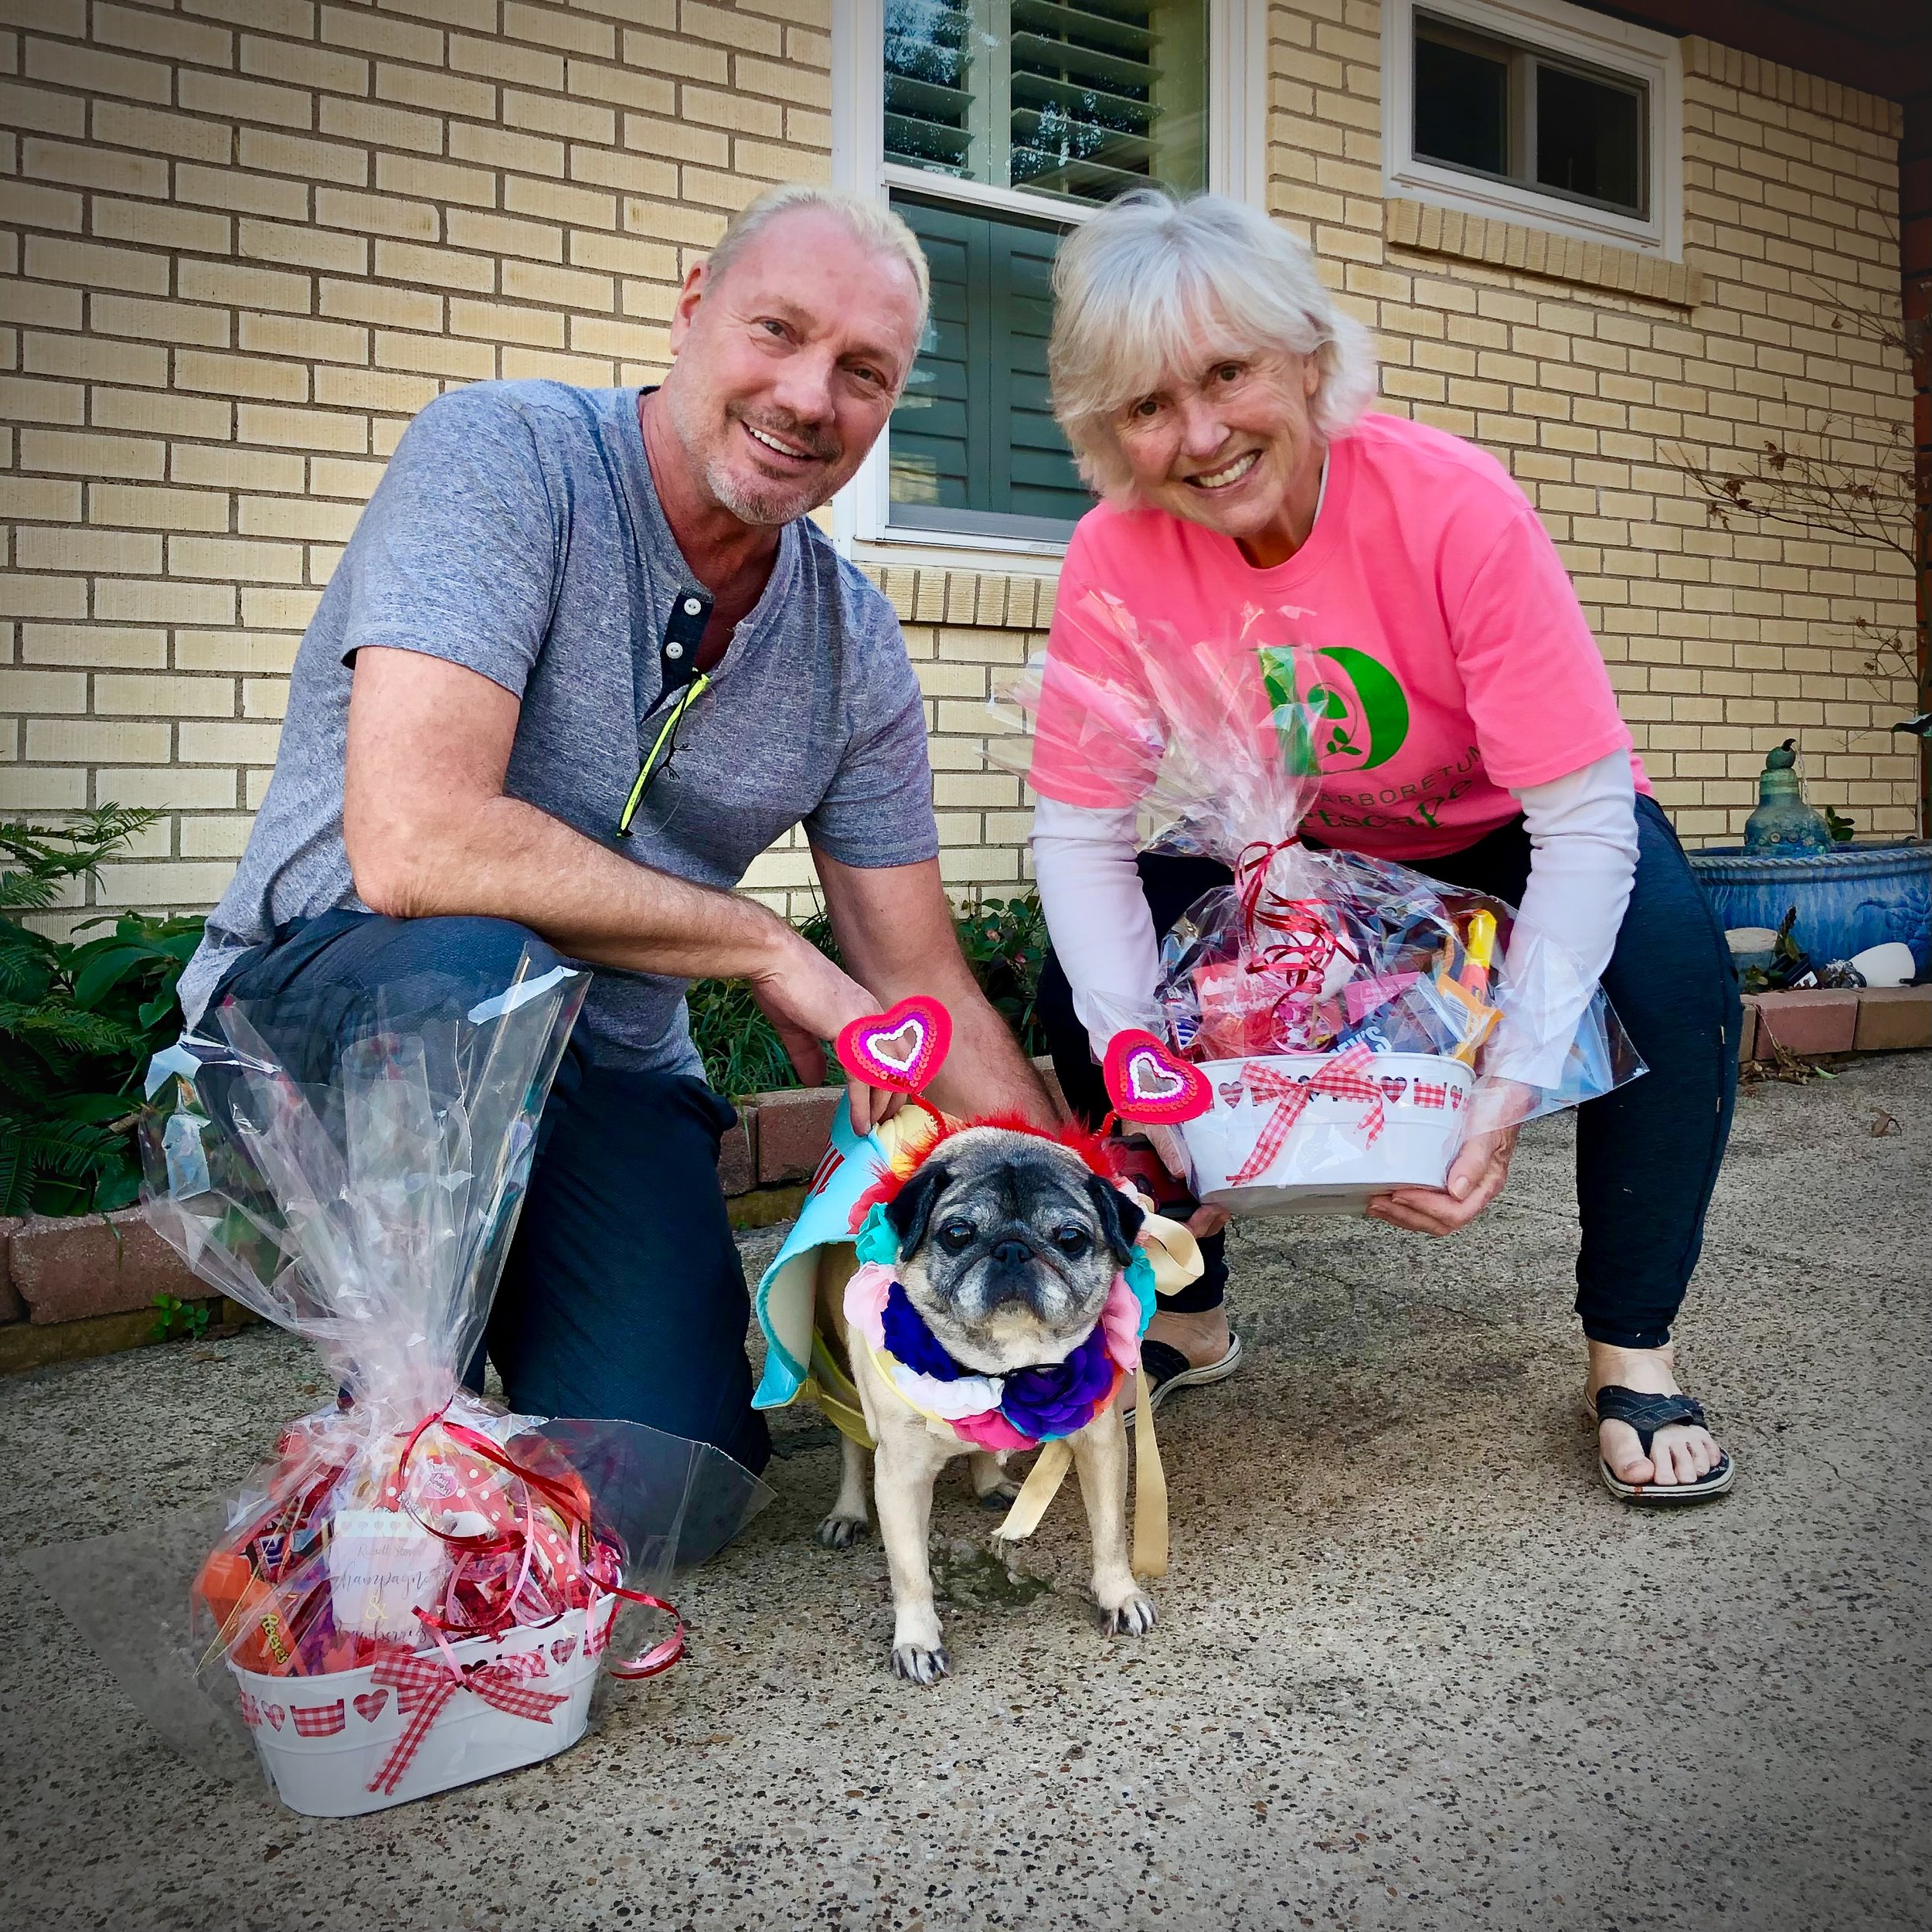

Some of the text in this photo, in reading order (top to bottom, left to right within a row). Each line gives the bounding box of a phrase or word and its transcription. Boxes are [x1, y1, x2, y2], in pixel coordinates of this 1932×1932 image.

[1298, 779, 1473, 829] rtscape
[365, 1594, 389, 1620] &
[258, 1613, 289, 1664] Reese's
